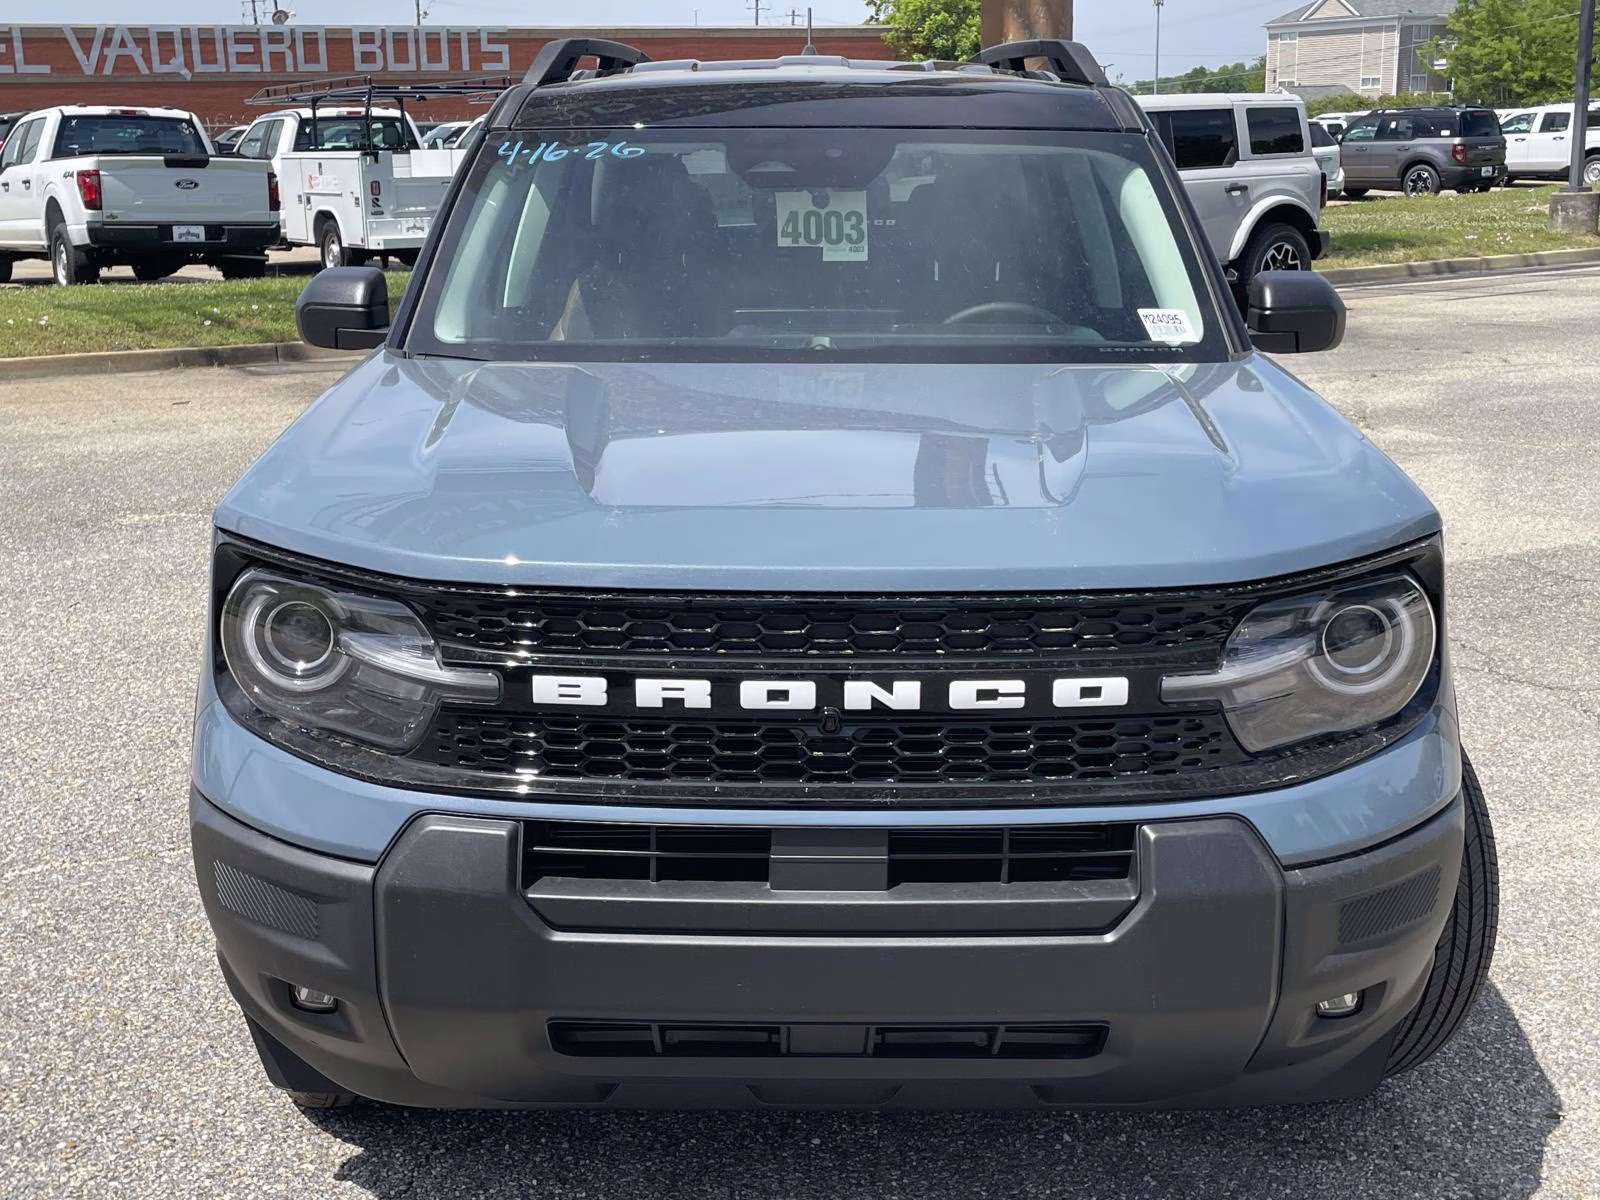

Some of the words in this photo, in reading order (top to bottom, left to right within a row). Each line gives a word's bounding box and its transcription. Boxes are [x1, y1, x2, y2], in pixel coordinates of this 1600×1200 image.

[62, 24, 328, 80] VAQUERO
[352, 25, 510, 72] BOOTS
[780, 210, 865, 245] 4003
[532, 675, 1129, 709] BRONCO
